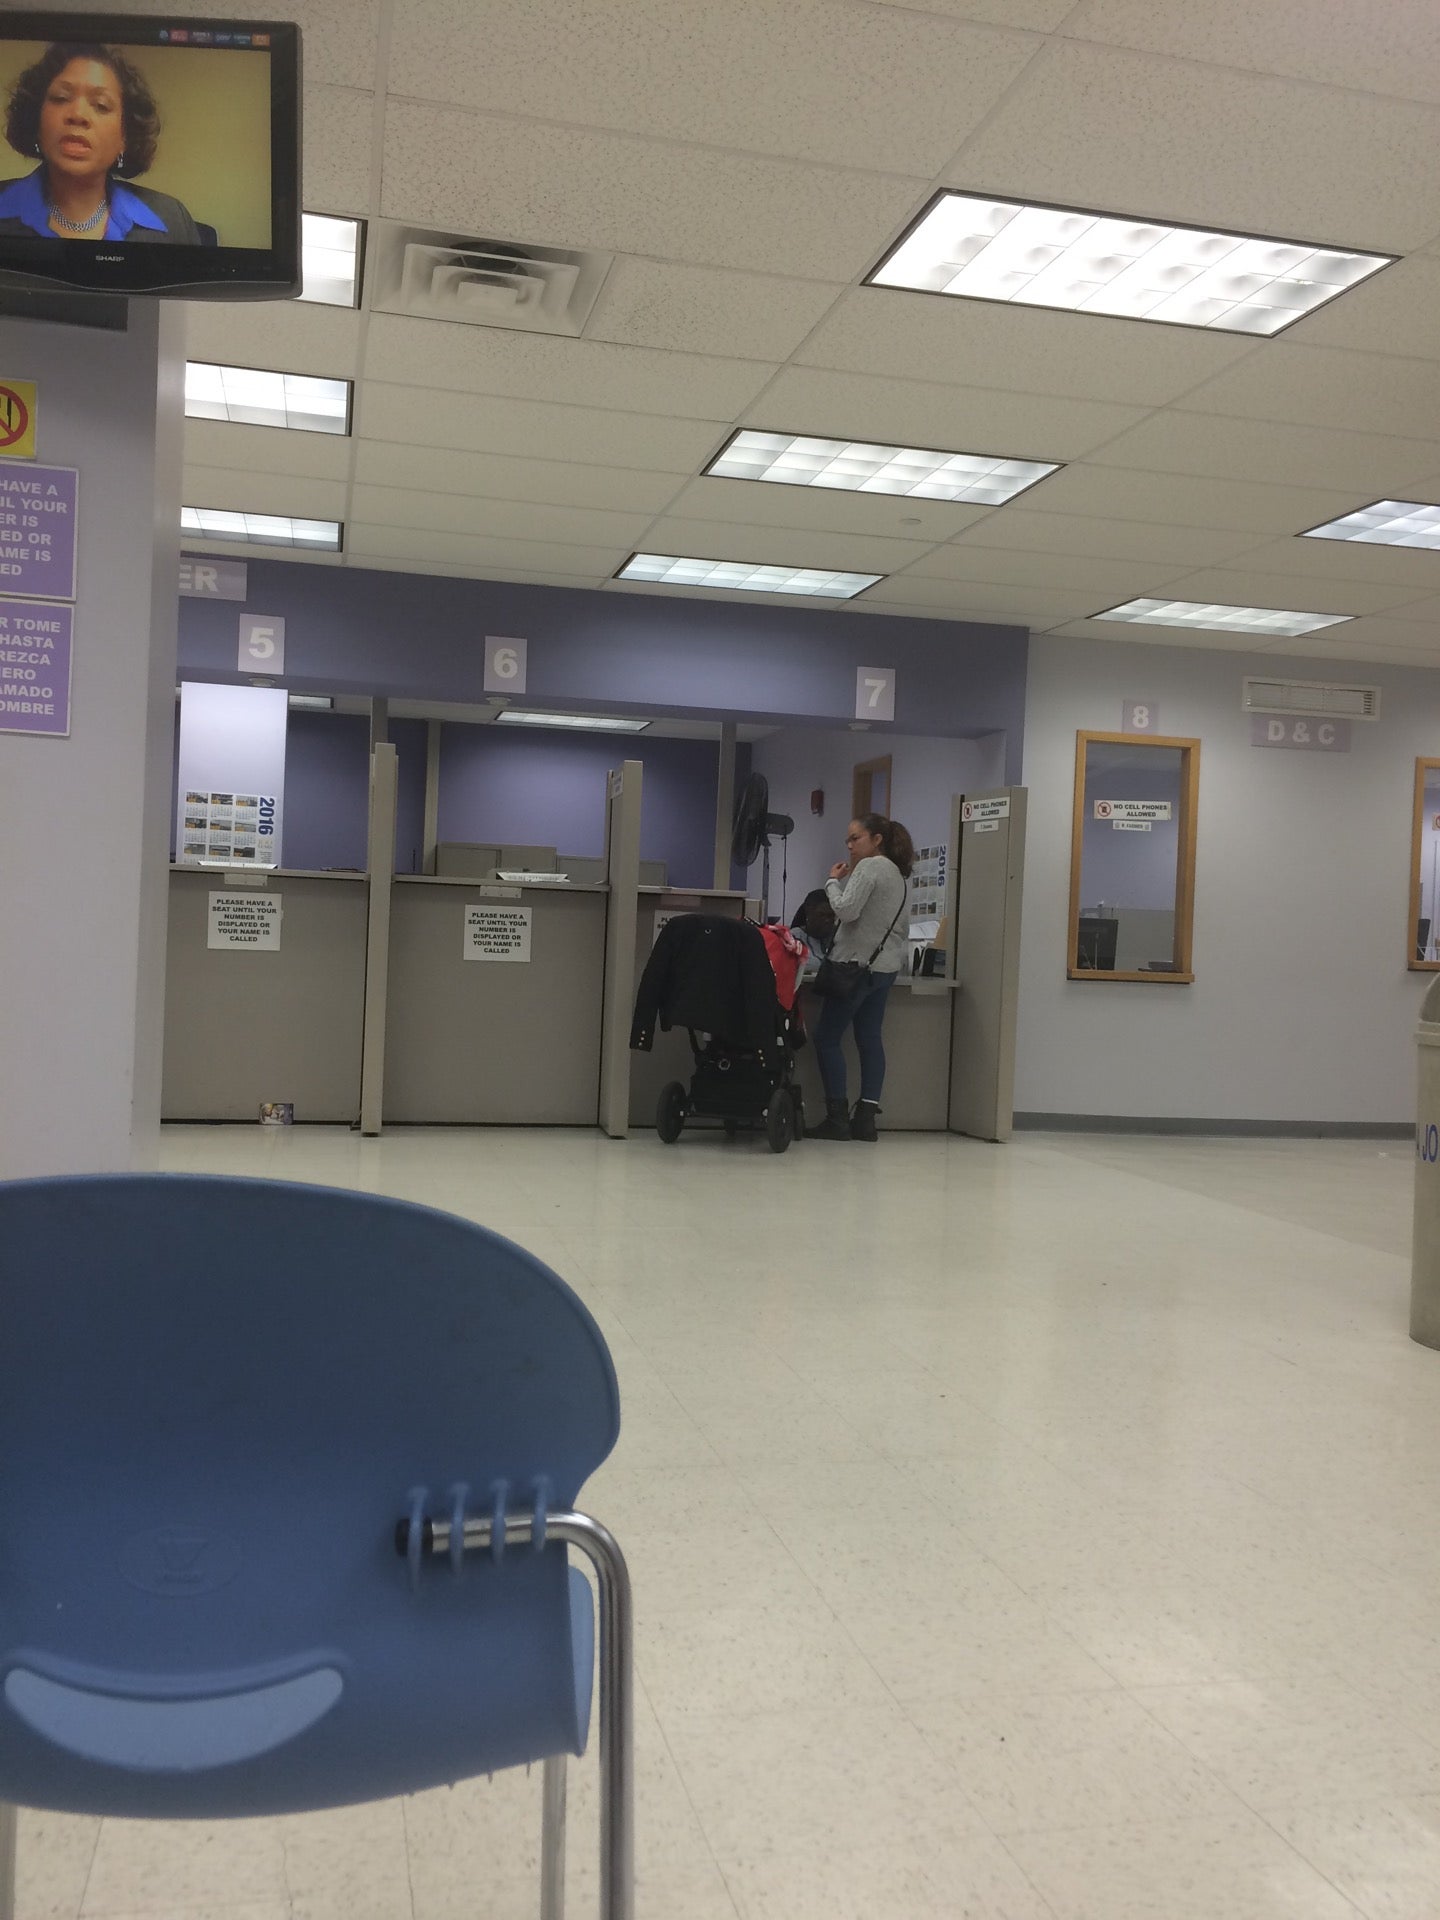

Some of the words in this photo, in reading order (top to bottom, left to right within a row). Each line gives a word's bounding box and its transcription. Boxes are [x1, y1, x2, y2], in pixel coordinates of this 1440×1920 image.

[0, 480, 41, 494] HAVE
[46, 485, 58, 496] A
[21, 498, 67, 513] YOUR
[22, 515, 39, 527] IS
[1, 530, 22, 542] ED
[28, 533, 51, 545] OR
[35, 550, 52, 561] IS
[0, 564, 22, 575] ED
[13, 618, 61, 633] TOME
[0, 634, 54, 649] HASTA
[249, 627, 275, 659] 5
[493, 648, 519, 679] 6
[0, 684, 53, 698] MADO
[864, 678, 887, 707] 7
[1132, 705, 1149, 729] 8
[1268, 720, 1285, 741] D
[1292, 722, 1310, 743] &
[1318, 723, 1335, 745] C
[258, 797, 275, 836] 2016
[938, 845, 947, 887] 2016
